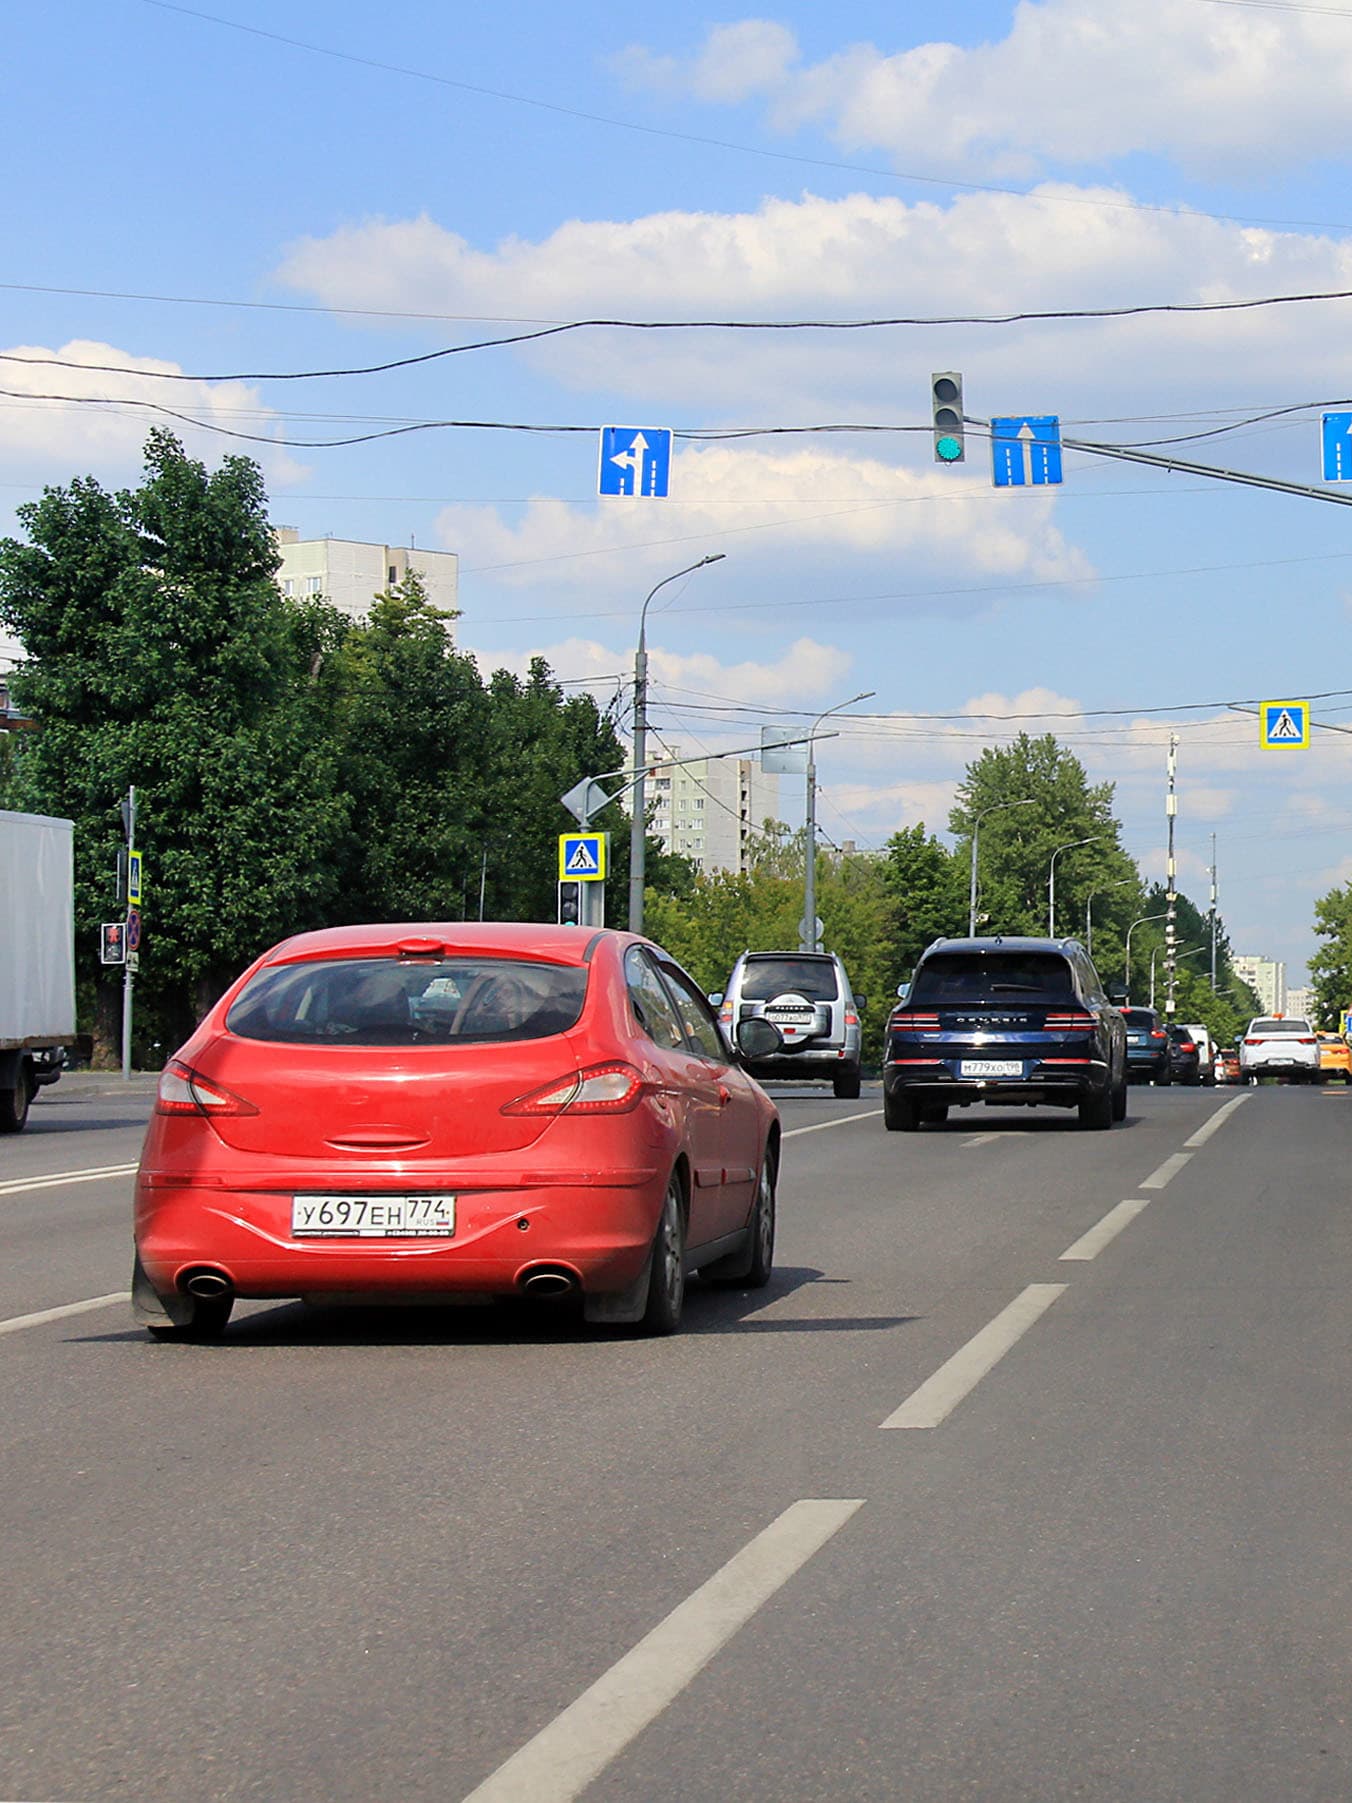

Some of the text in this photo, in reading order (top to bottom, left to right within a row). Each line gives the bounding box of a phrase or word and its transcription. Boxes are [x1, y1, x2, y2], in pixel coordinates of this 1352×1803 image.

[303, 1199, 446, 1226] У697ЕН 774
[416, 1218, 434, 1226] RUS
